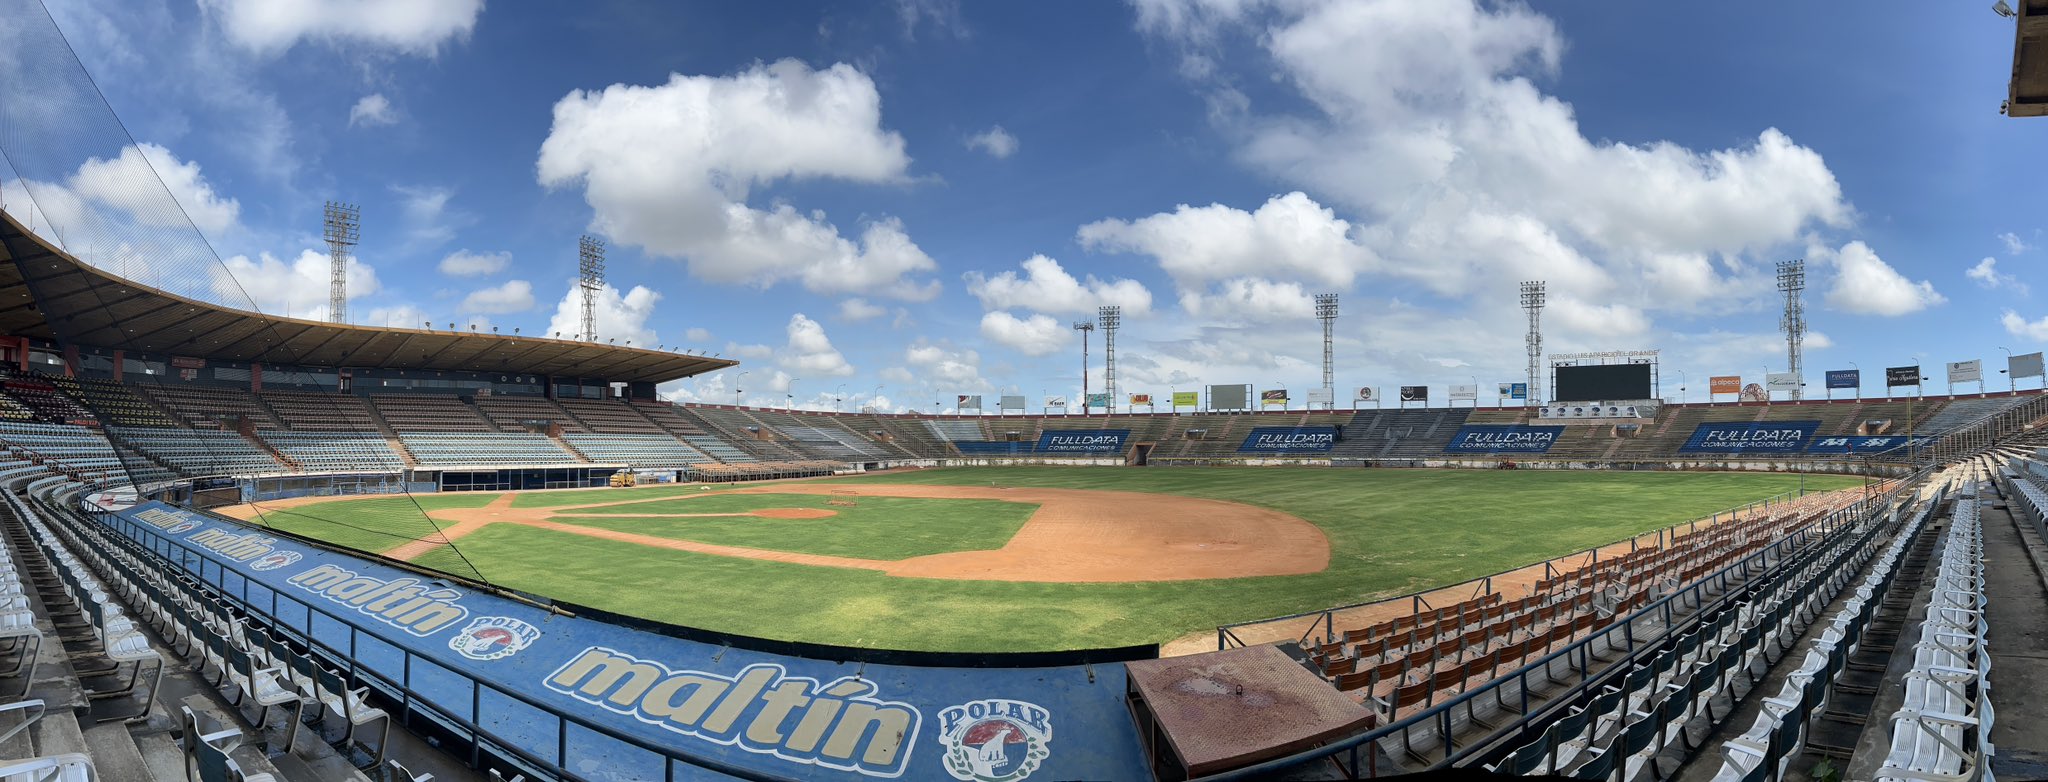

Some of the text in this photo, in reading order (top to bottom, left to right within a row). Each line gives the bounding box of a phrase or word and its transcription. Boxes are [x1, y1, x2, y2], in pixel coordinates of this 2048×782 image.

[1051, 435, 1118, 444] FULLDATA
[1258, 433, 1332, 442] FULLDATA
[1465, 432, 1552, 442] FULLDATA
[1706, 429, 1801, 440] FULLDATA
[292, 565, 463, 634] maltín
[470, 617, 538, 646] POLAR
[550, 648, 914, 768] maltín
[942, 701, 1048, 738] POLAR
